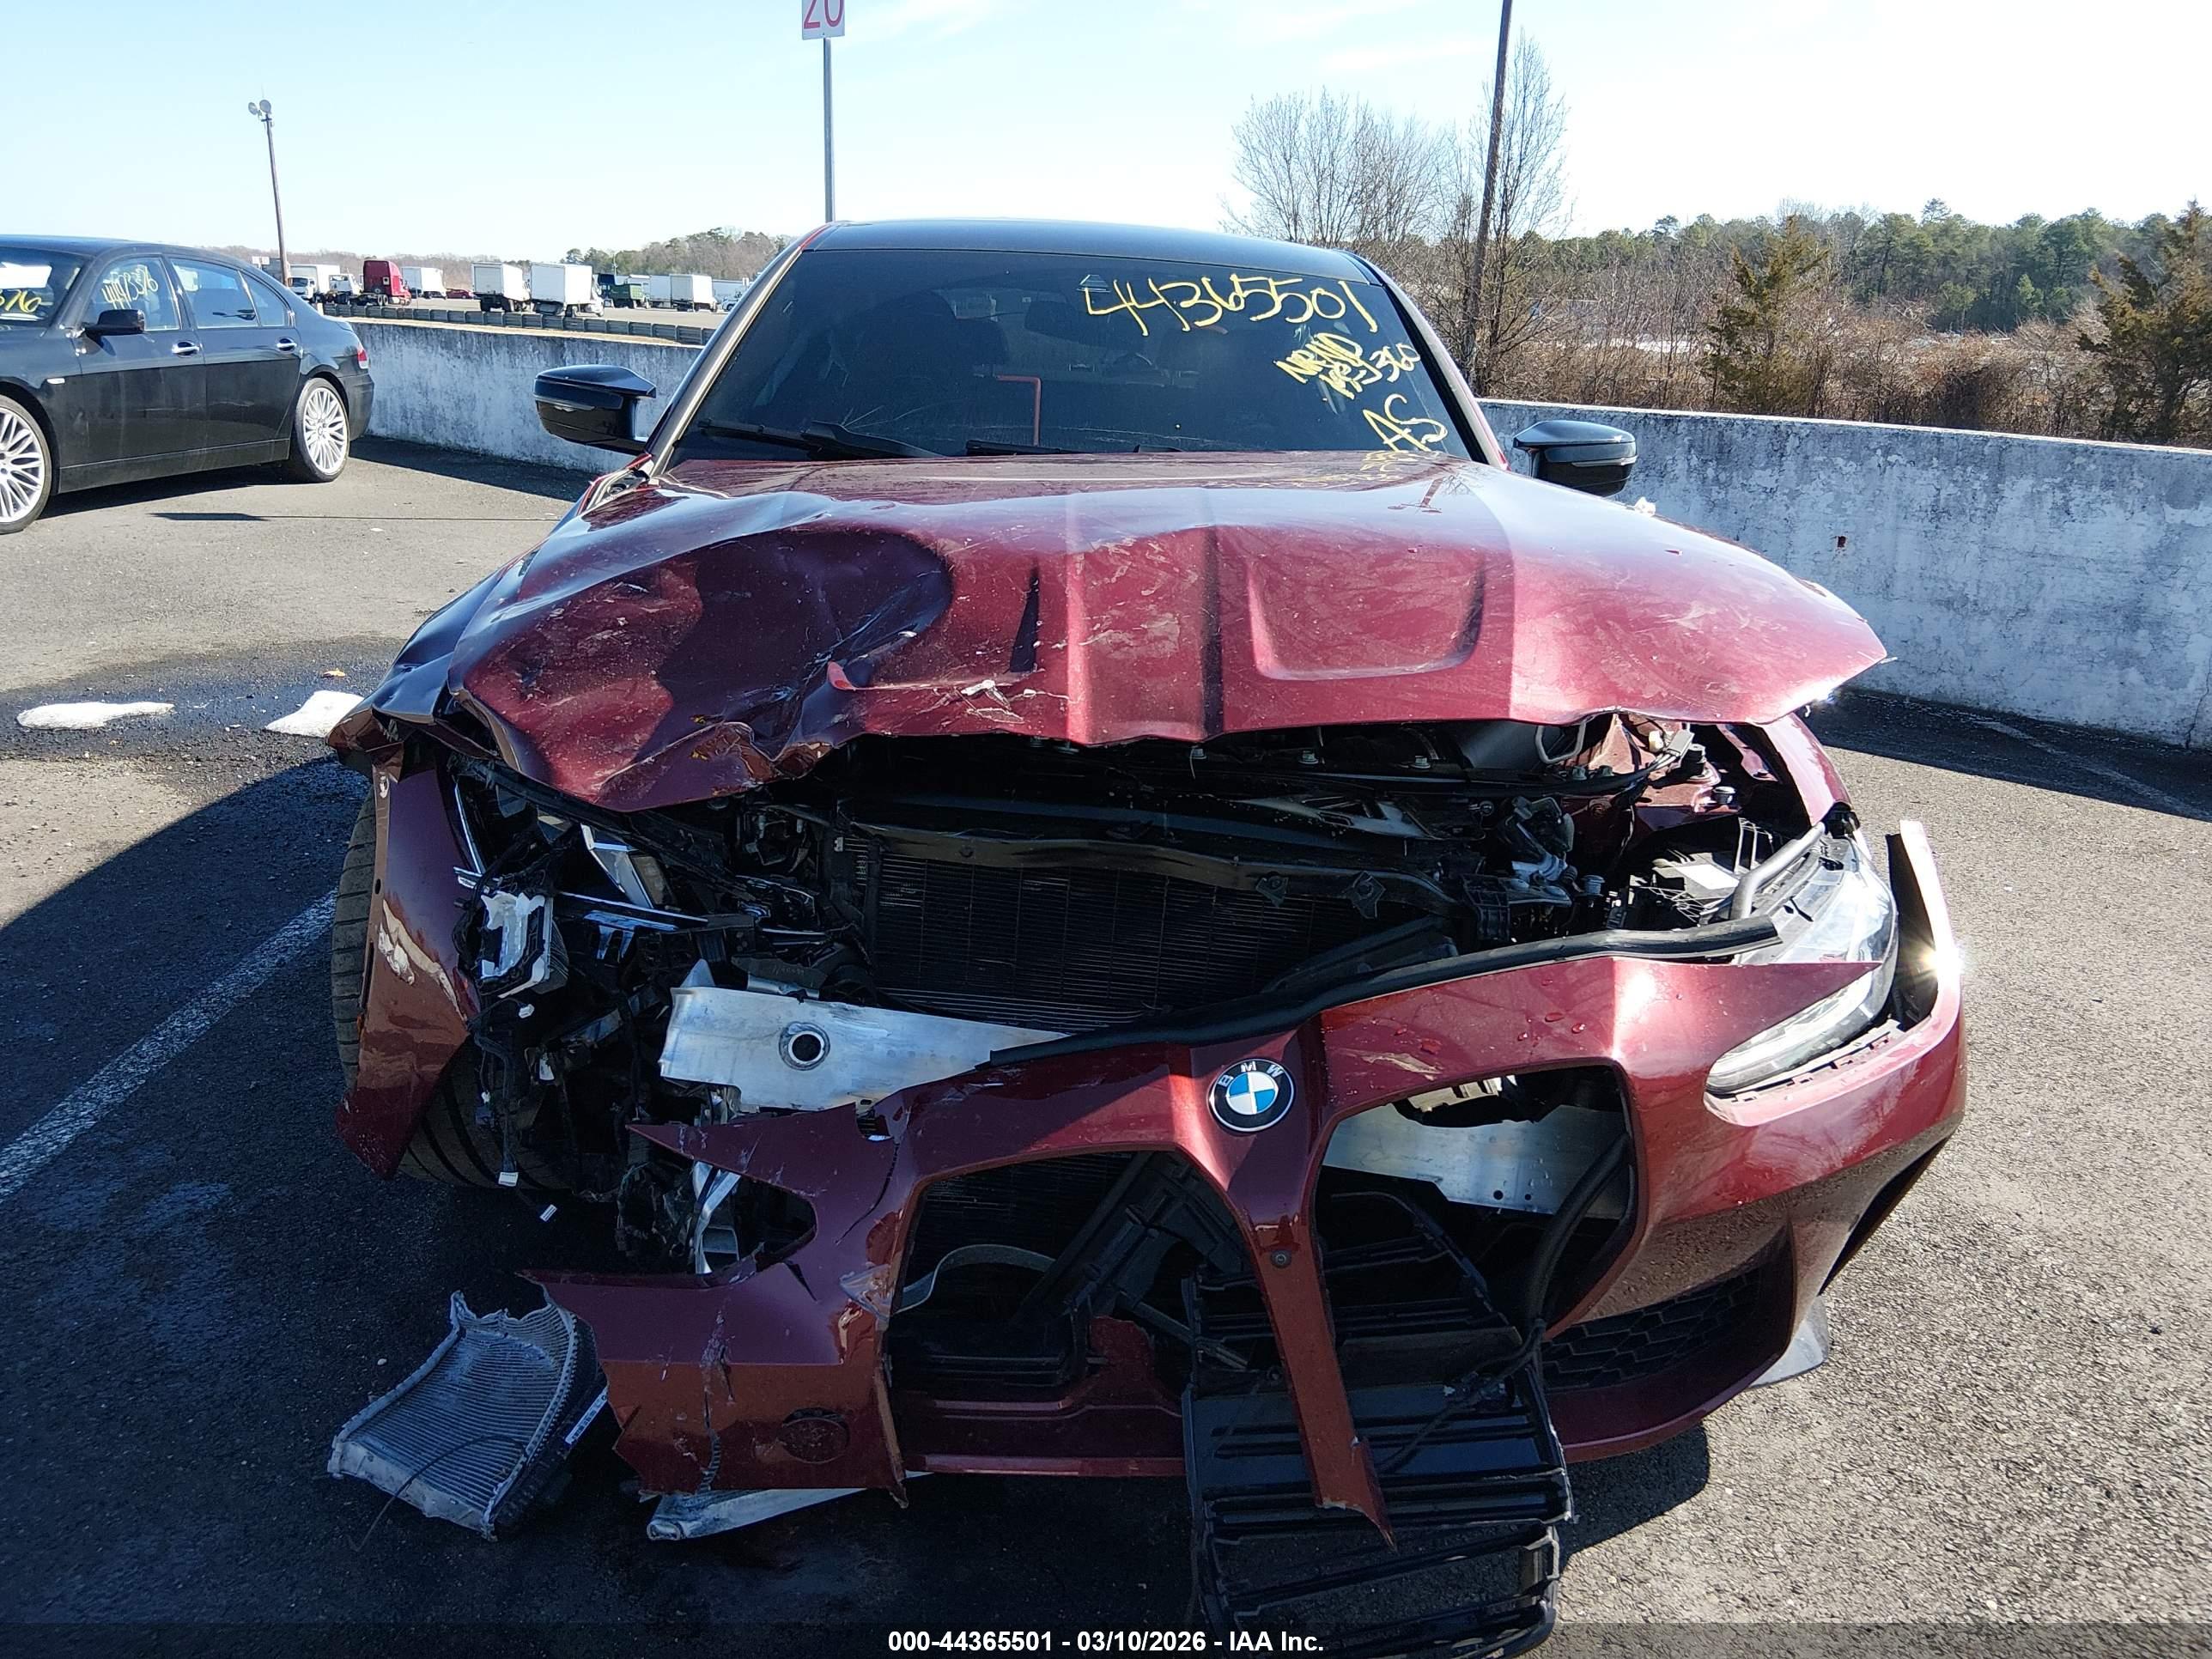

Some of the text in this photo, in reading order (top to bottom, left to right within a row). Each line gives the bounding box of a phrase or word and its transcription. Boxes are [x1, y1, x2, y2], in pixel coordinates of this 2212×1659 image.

[1083, 273, 1379, 337] 44365501
[1362, 393, 1449, 453] AS
[1217, 1060, 1285, 1088] BMW
